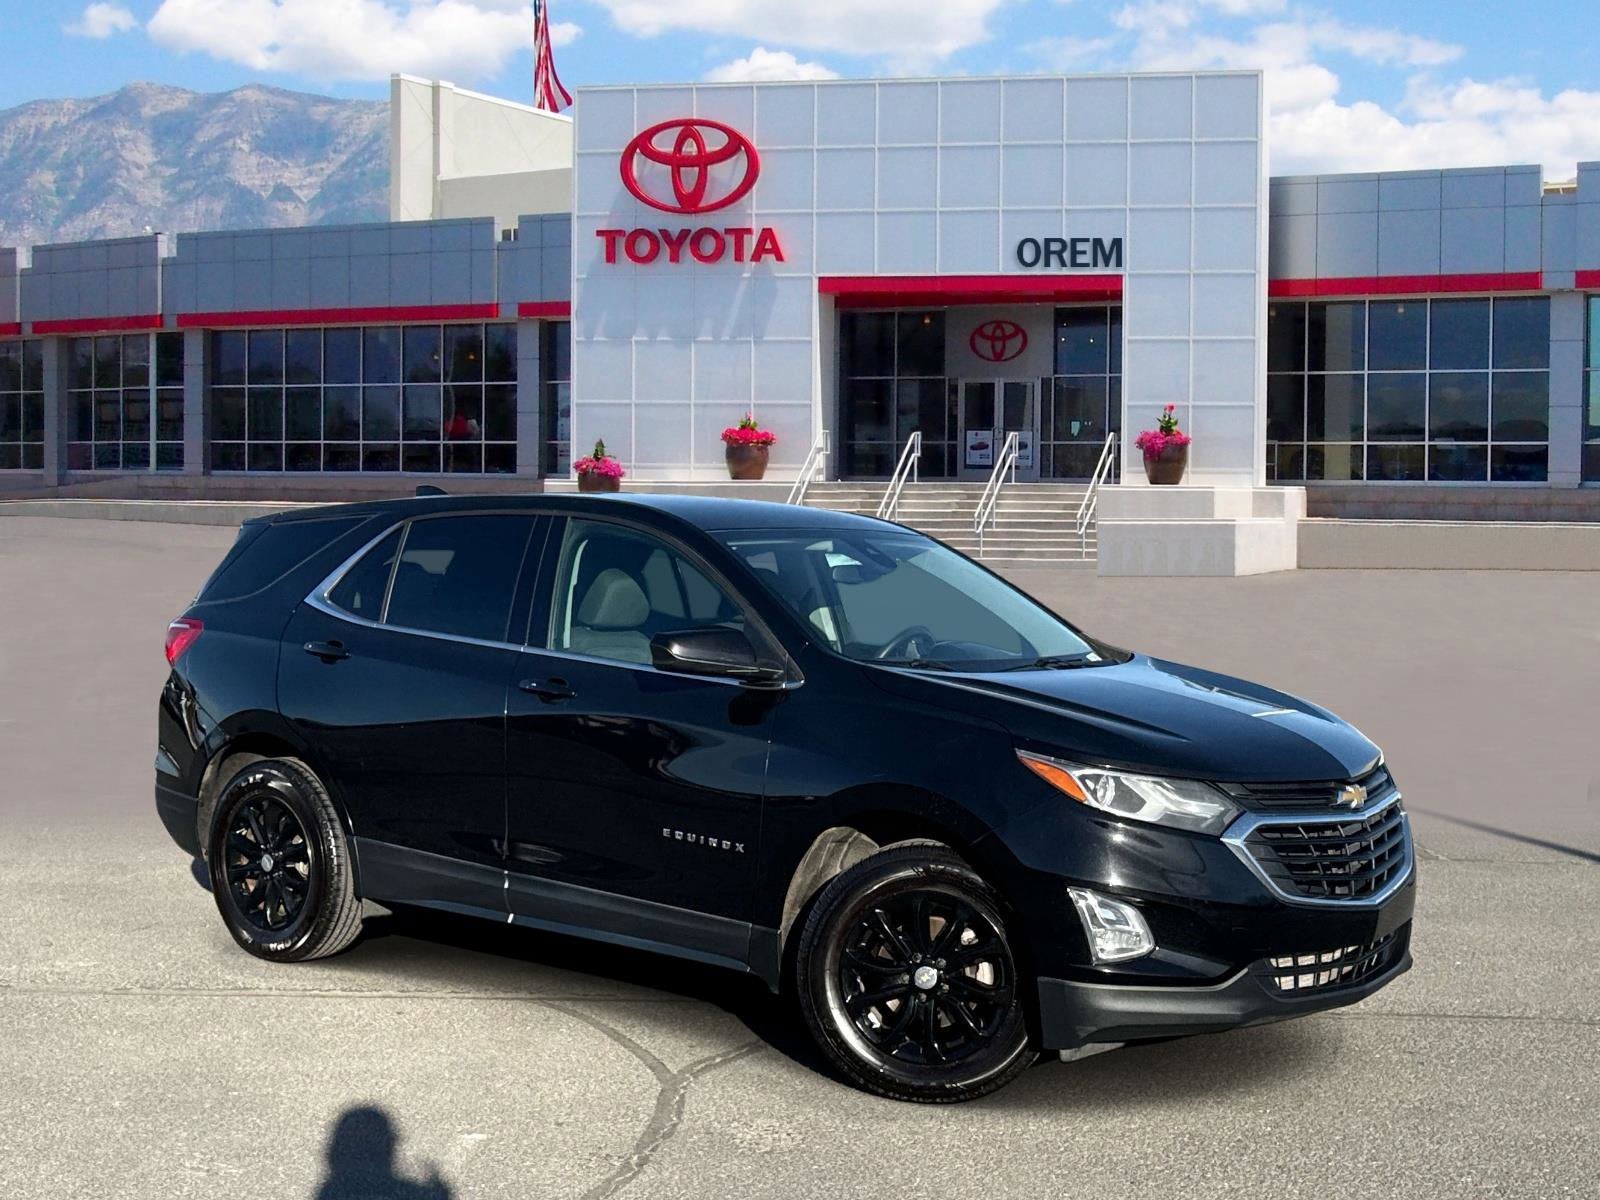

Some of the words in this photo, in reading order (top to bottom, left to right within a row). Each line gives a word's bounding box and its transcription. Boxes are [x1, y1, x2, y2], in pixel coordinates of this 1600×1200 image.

[596, 227, 785, 265] TOYOTA
[1016, 237, 1123, 268] OREM
[662, 828, 745, 853] EQUINOX
